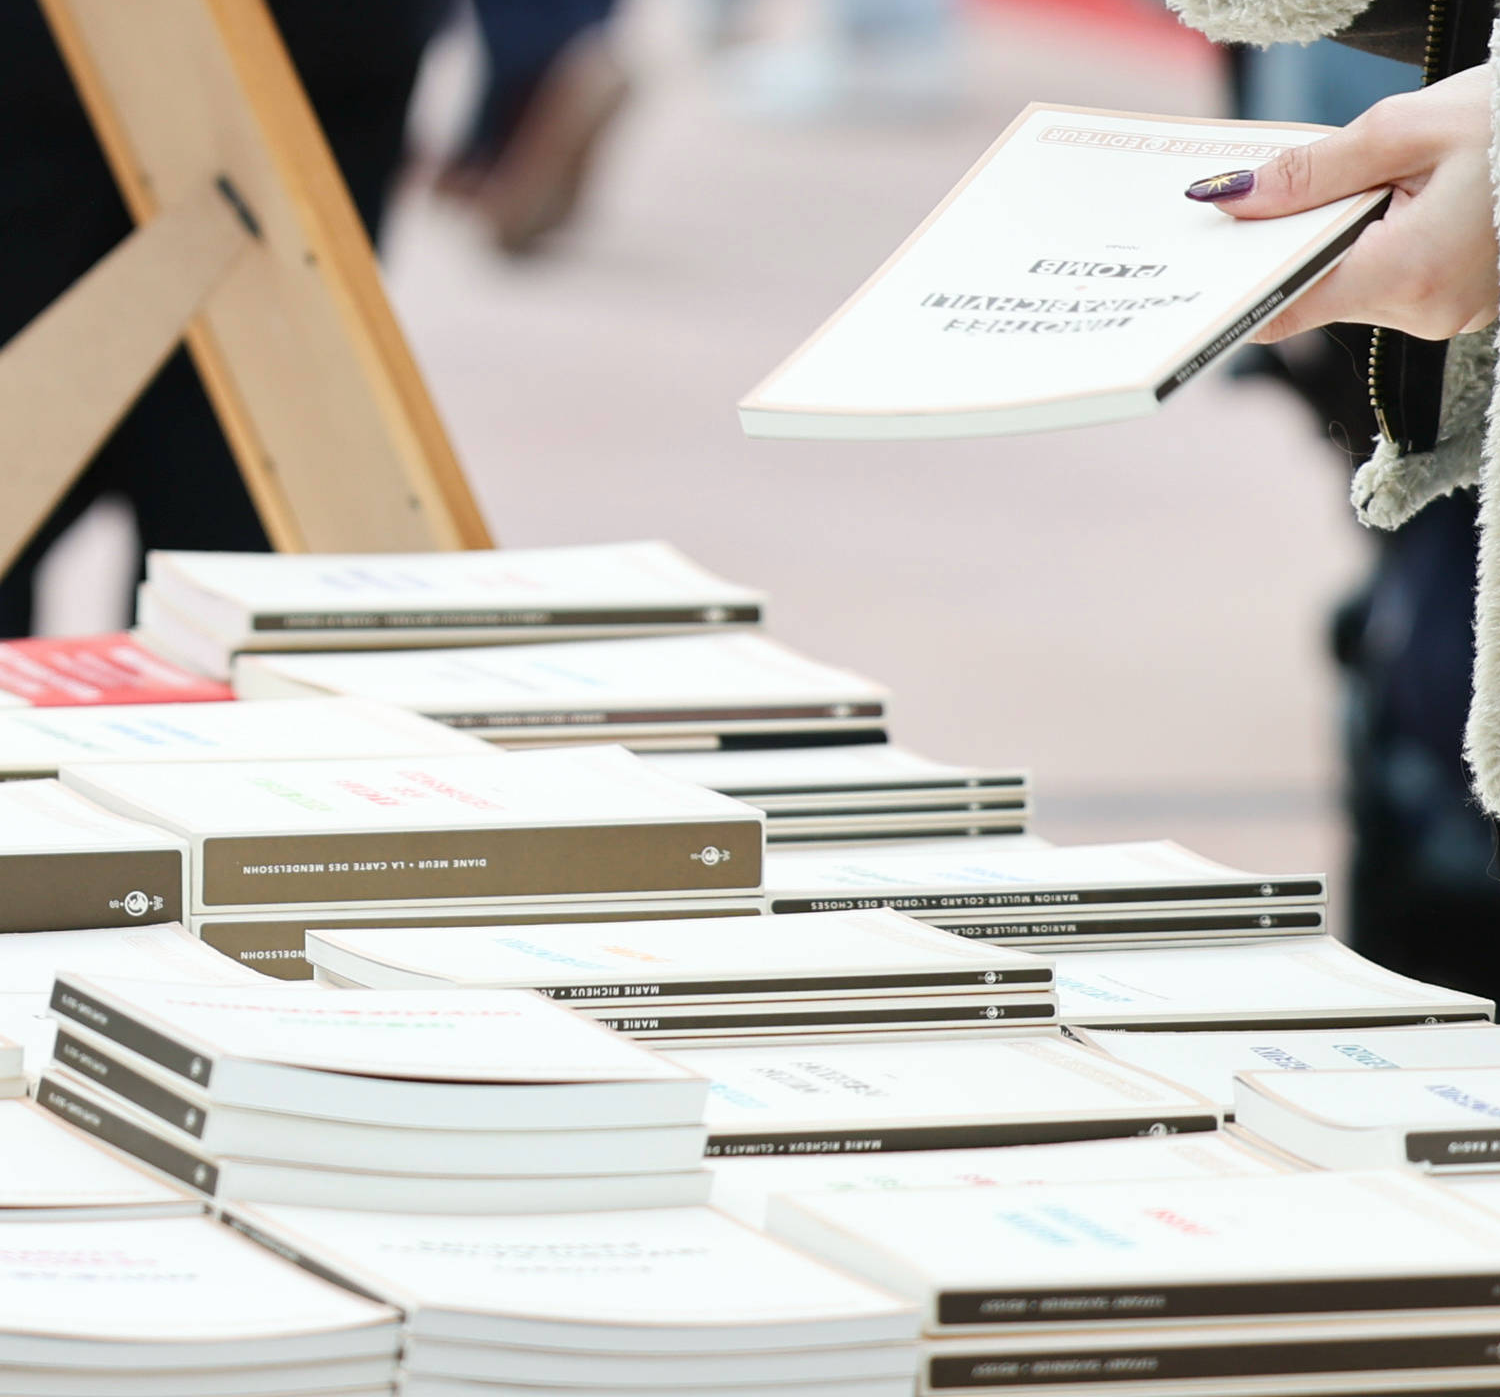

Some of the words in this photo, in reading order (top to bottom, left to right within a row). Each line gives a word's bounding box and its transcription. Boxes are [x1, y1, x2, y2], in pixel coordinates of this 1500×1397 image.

[1028, 259, 1168, 279] PLOMB
[328, 863, 350, 872] DES
[353, 861, 388, 871] CARTE
[390, 860, 405, 870] LA
[417, 859, 449, 869] MEUR
[452, 857, 487, 868] DIANE
[242, 864, 325, 875] MENDELSSOHN
[240, 949, 305, 960] NDELSSOHN
[569, 986, 620, 998] RICHEUX
[623, 985, 660, 996] MARIE
[622, 1018, 659, 1030] MARIE
[788, 1141, 841, 1153] RICHEUX
[844, 1139, 882, 1151] MARIE
